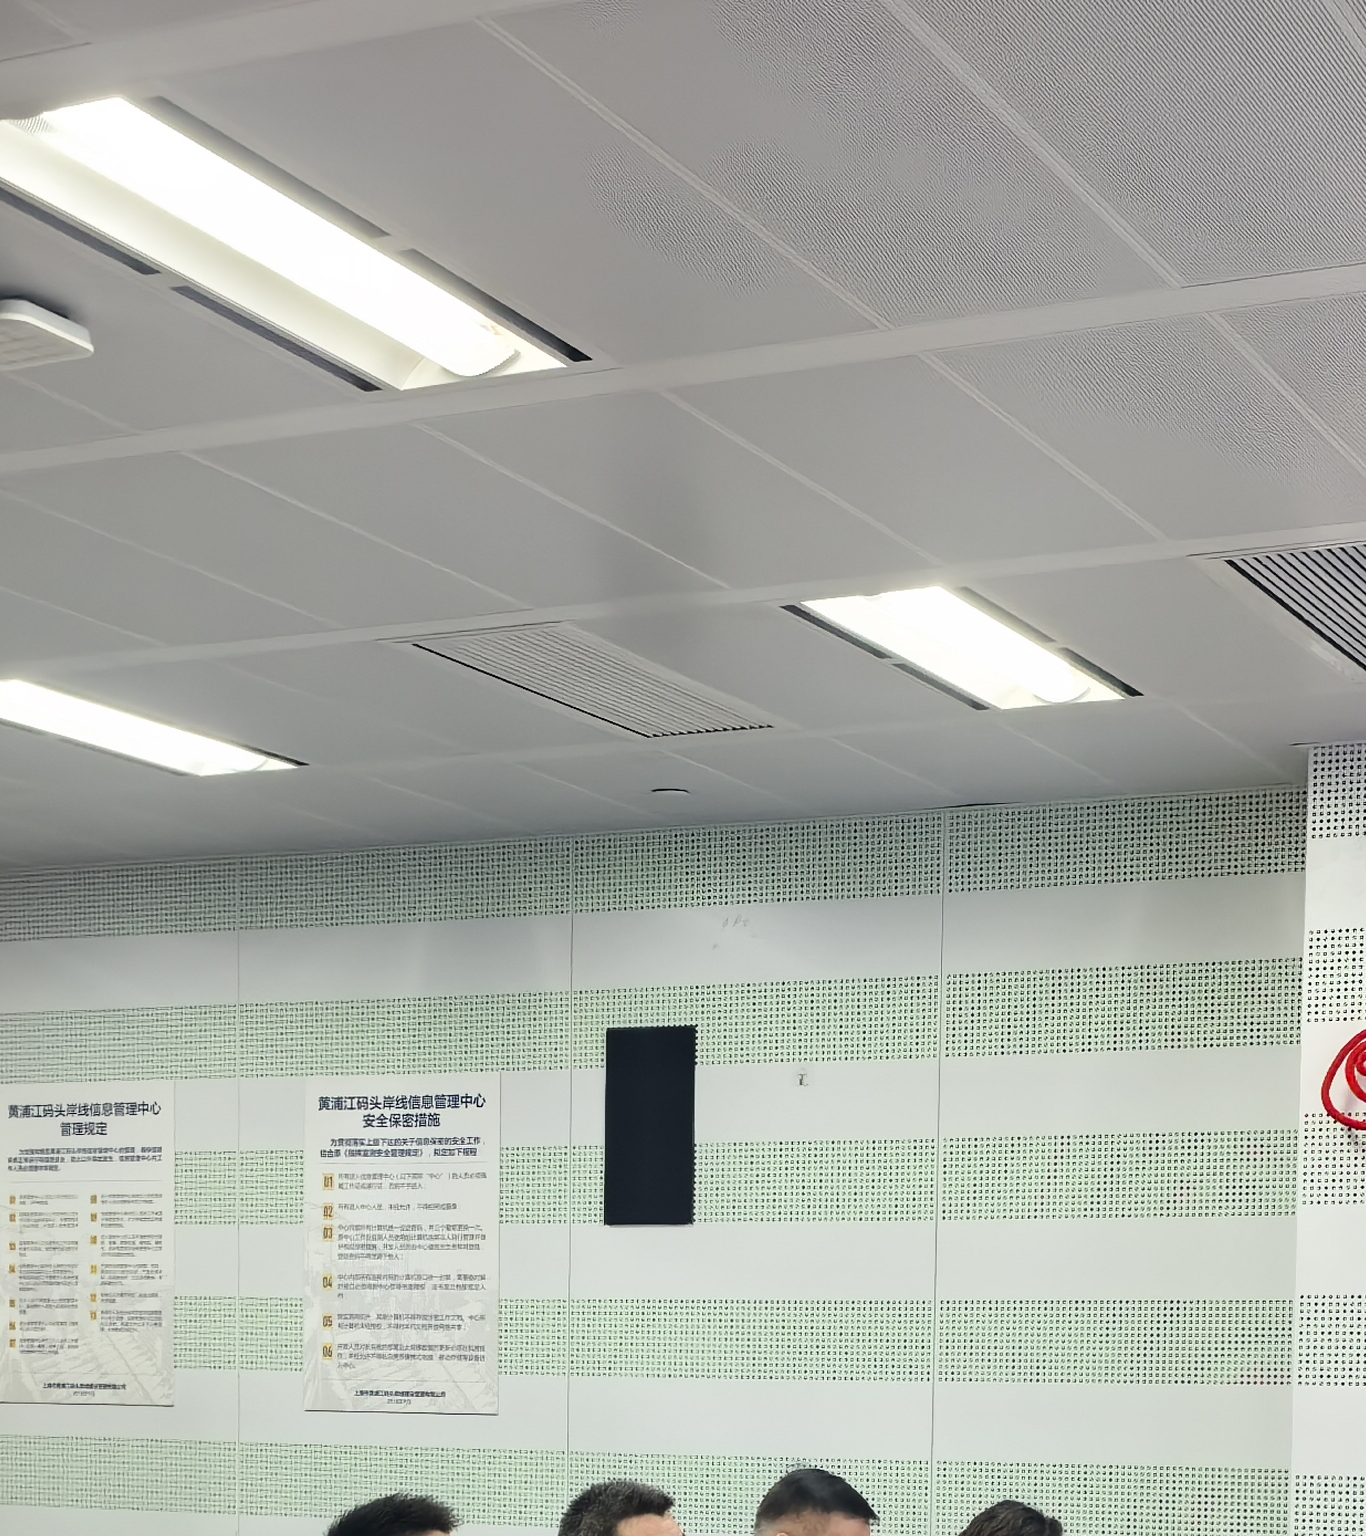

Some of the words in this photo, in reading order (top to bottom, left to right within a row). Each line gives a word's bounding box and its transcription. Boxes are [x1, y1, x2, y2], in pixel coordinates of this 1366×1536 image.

[8, 1101, 161, 1118] 黄浦江码头岸线信息管理中心
[318, 1093, 486, 1111] 黄浦江码头岸线信息管理中心
[362, 1112, 441, 1128] 安全保密措施
[60, 1122, 108, 1136] 管理规定
[323, 1227, 333, 1239] 03
